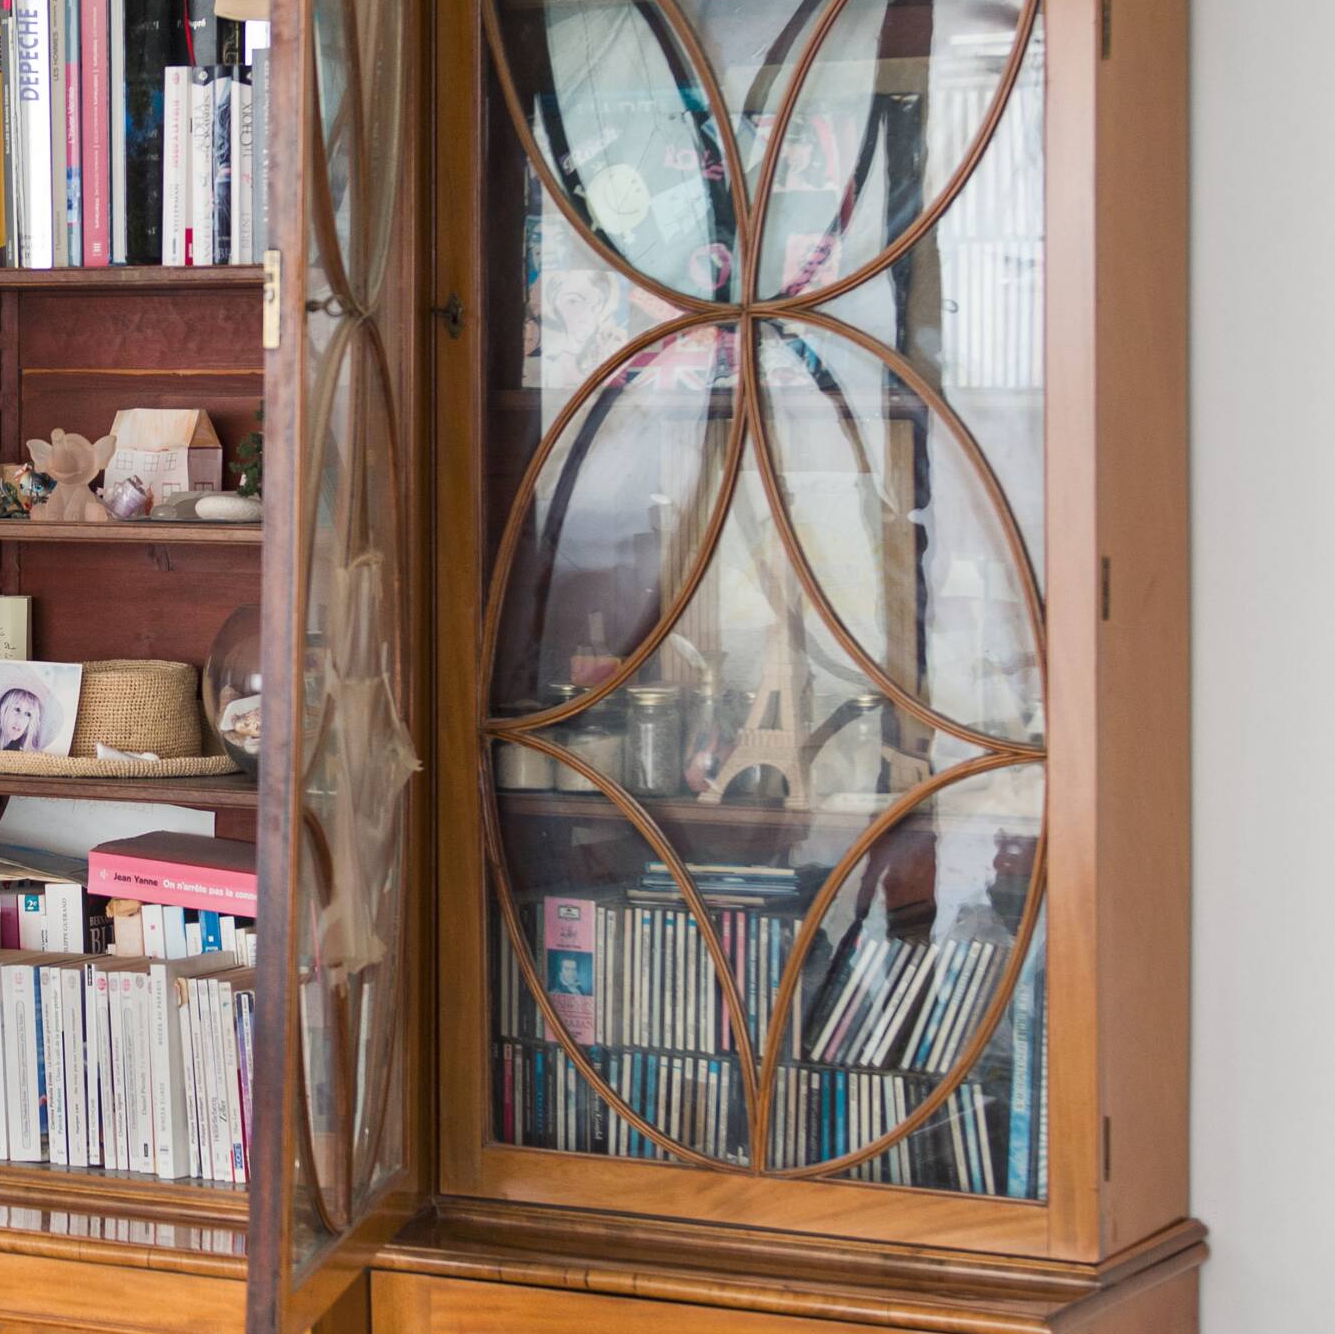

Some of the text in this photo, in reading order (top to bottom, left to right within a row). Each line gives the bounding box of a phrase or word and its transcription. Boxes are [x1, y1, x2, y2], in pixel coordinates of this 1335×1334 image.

[19, 9, 39, 101] DEPECHE
[113, 873, 131, 882] Jean
[134, 876, 158, 886] Yanne
[163, 880, 175, 889] On
[209, 887, 224, 895] pas
